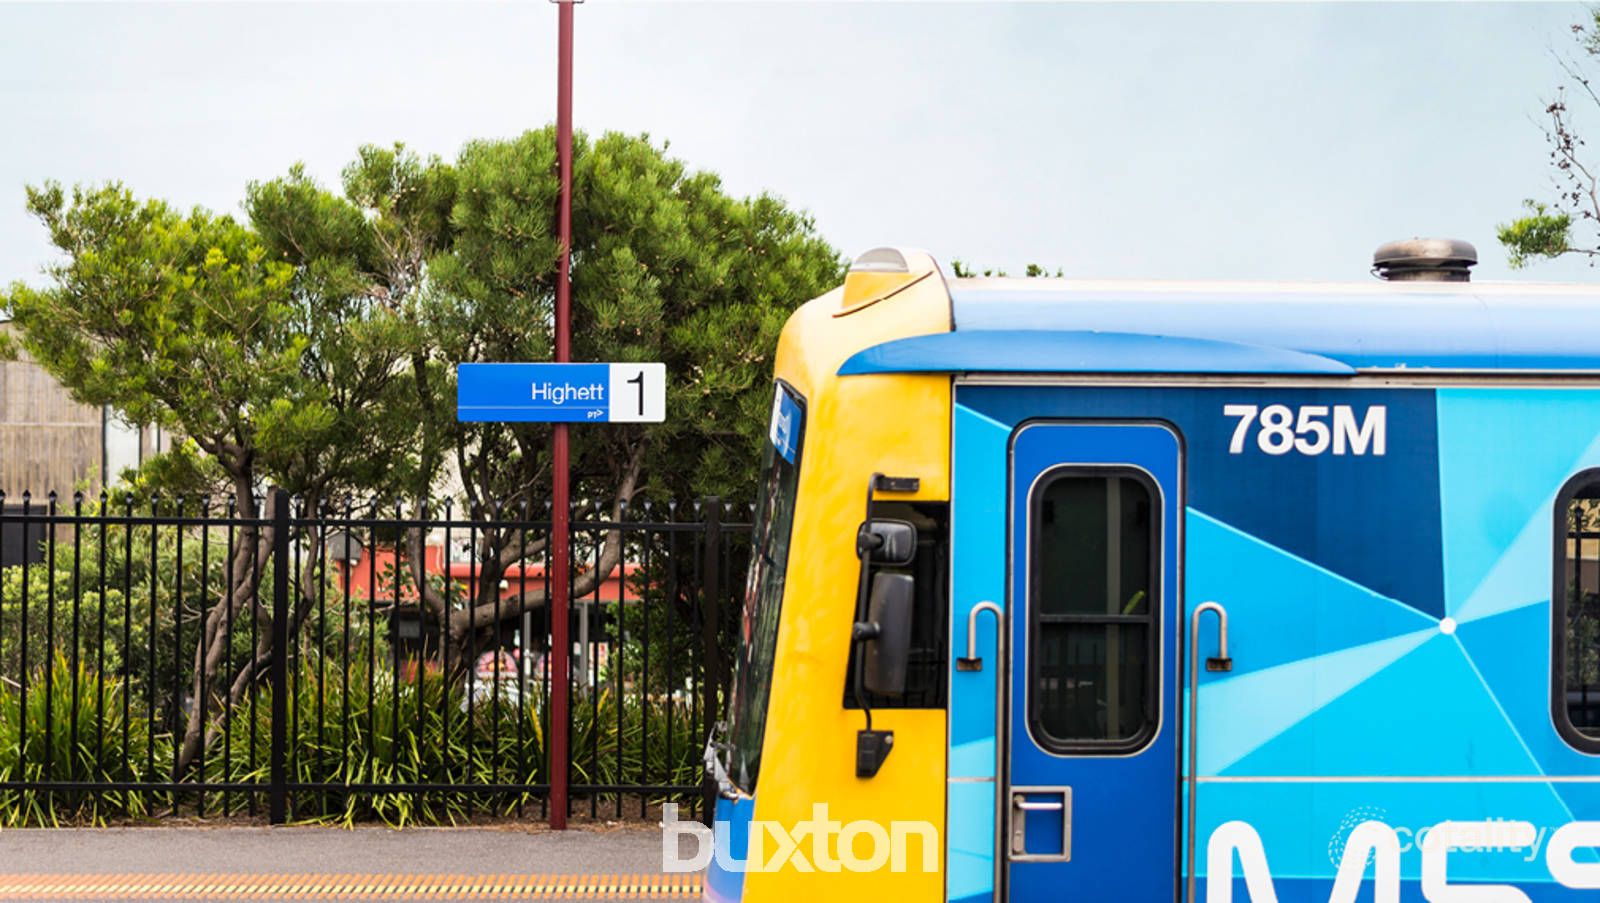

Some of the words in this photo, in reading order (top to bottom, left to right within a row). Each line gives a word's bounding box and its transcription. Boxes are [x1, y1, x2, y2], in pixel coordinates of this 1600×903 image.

[531, 383, 604, 404] Highett
[627, 371, 644, 416] 1
[1223, 404, 1387, 456] 785M
